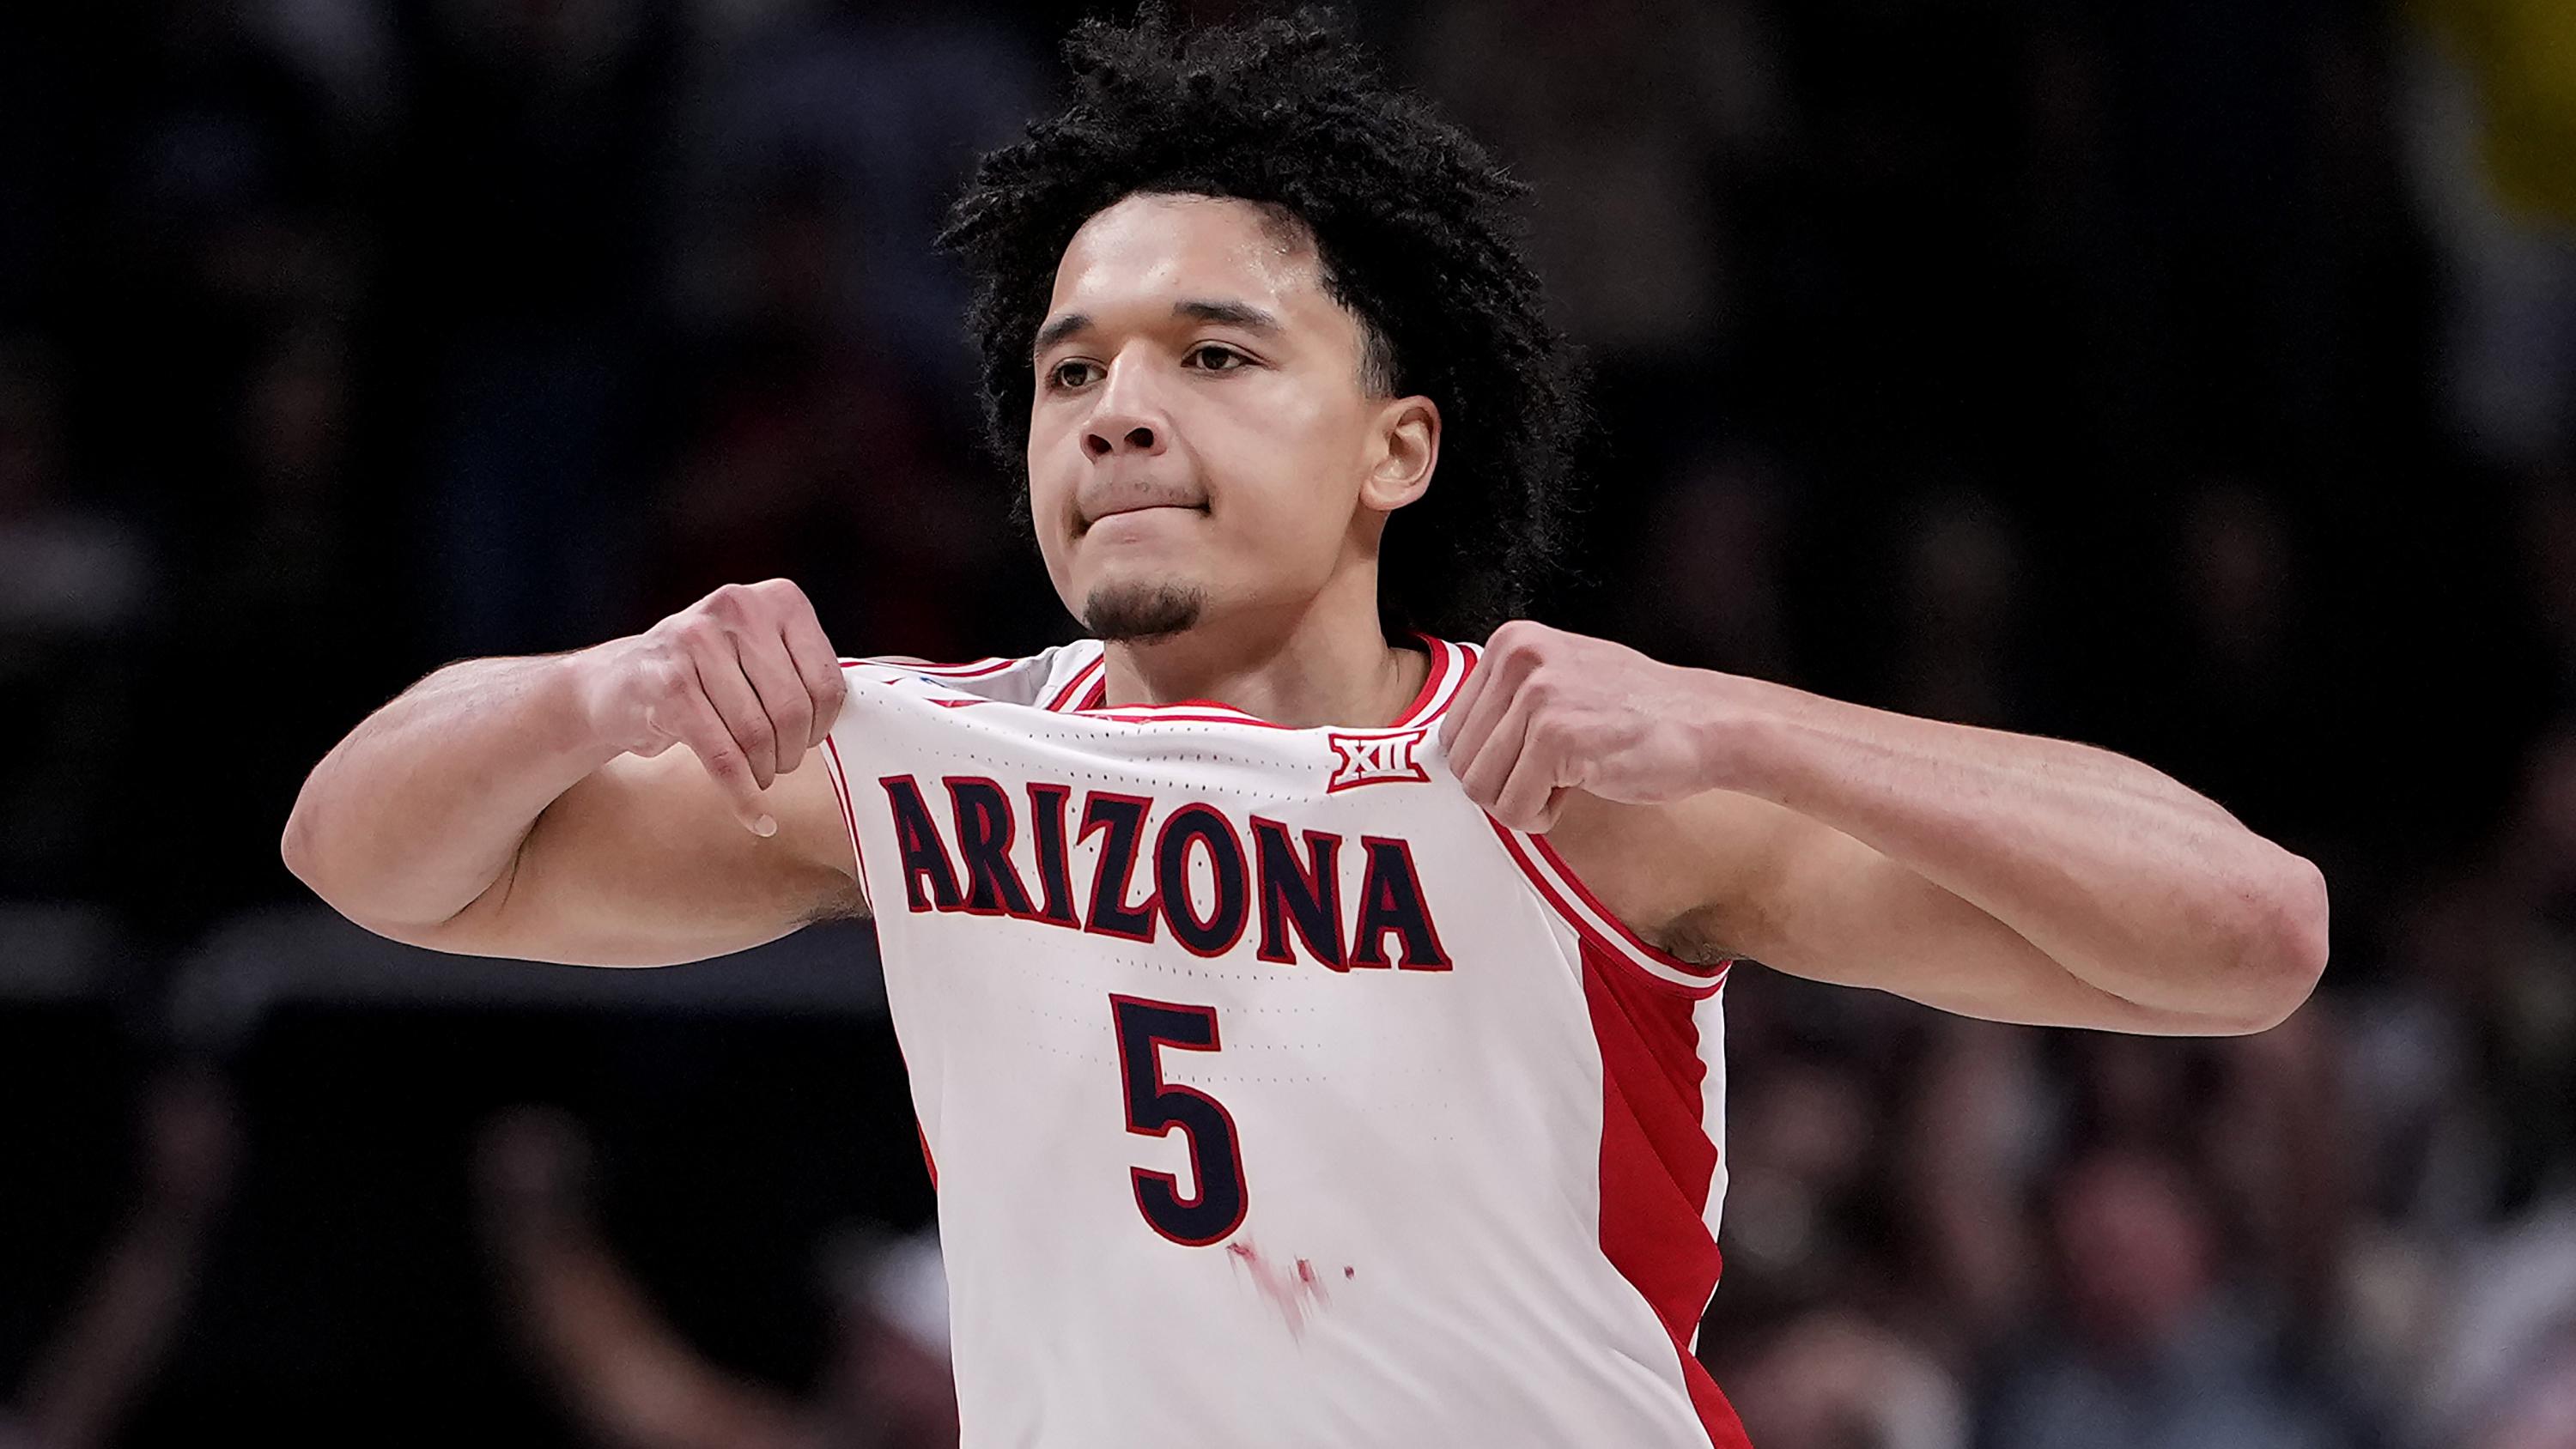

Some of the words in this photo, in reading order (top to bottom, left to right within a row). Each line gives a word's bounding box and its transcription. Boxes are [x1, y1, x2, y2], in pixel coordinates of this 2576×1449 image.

[1327, 730, 1431, 793] XII
[878, 773, 1453, 973] ARIZONA
[1109, 993, 1249, 1247] 5
